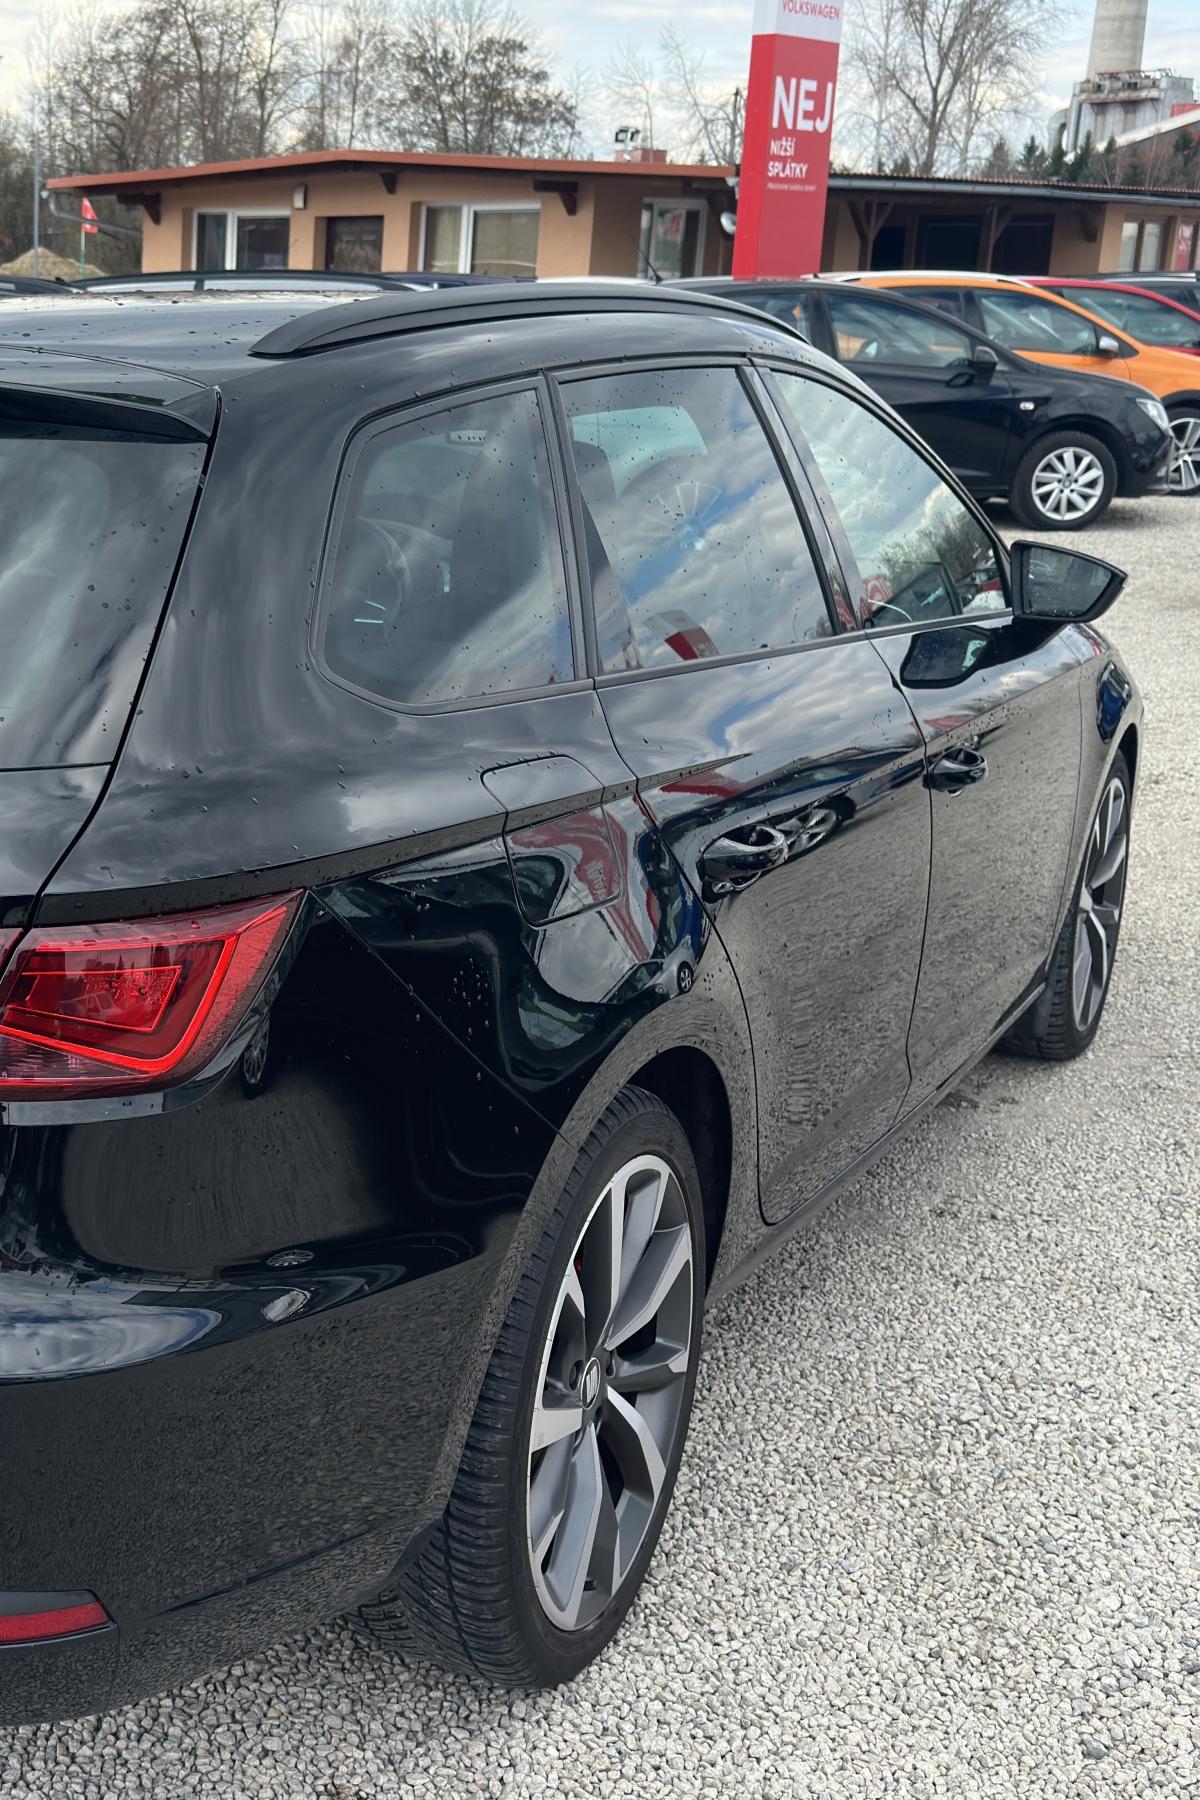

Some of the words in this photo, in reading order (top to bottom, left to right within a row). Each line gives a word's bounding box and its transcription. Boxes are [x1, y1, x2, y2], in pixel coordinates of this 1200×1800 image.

[782, 0, 840, 19] VOLKSWAGEN
[772, 75, 833, 133] NEJ
[770, 136, 796, 157] NIŽŠÍ
[767, 158, 808, 179] SPLÁTKY
